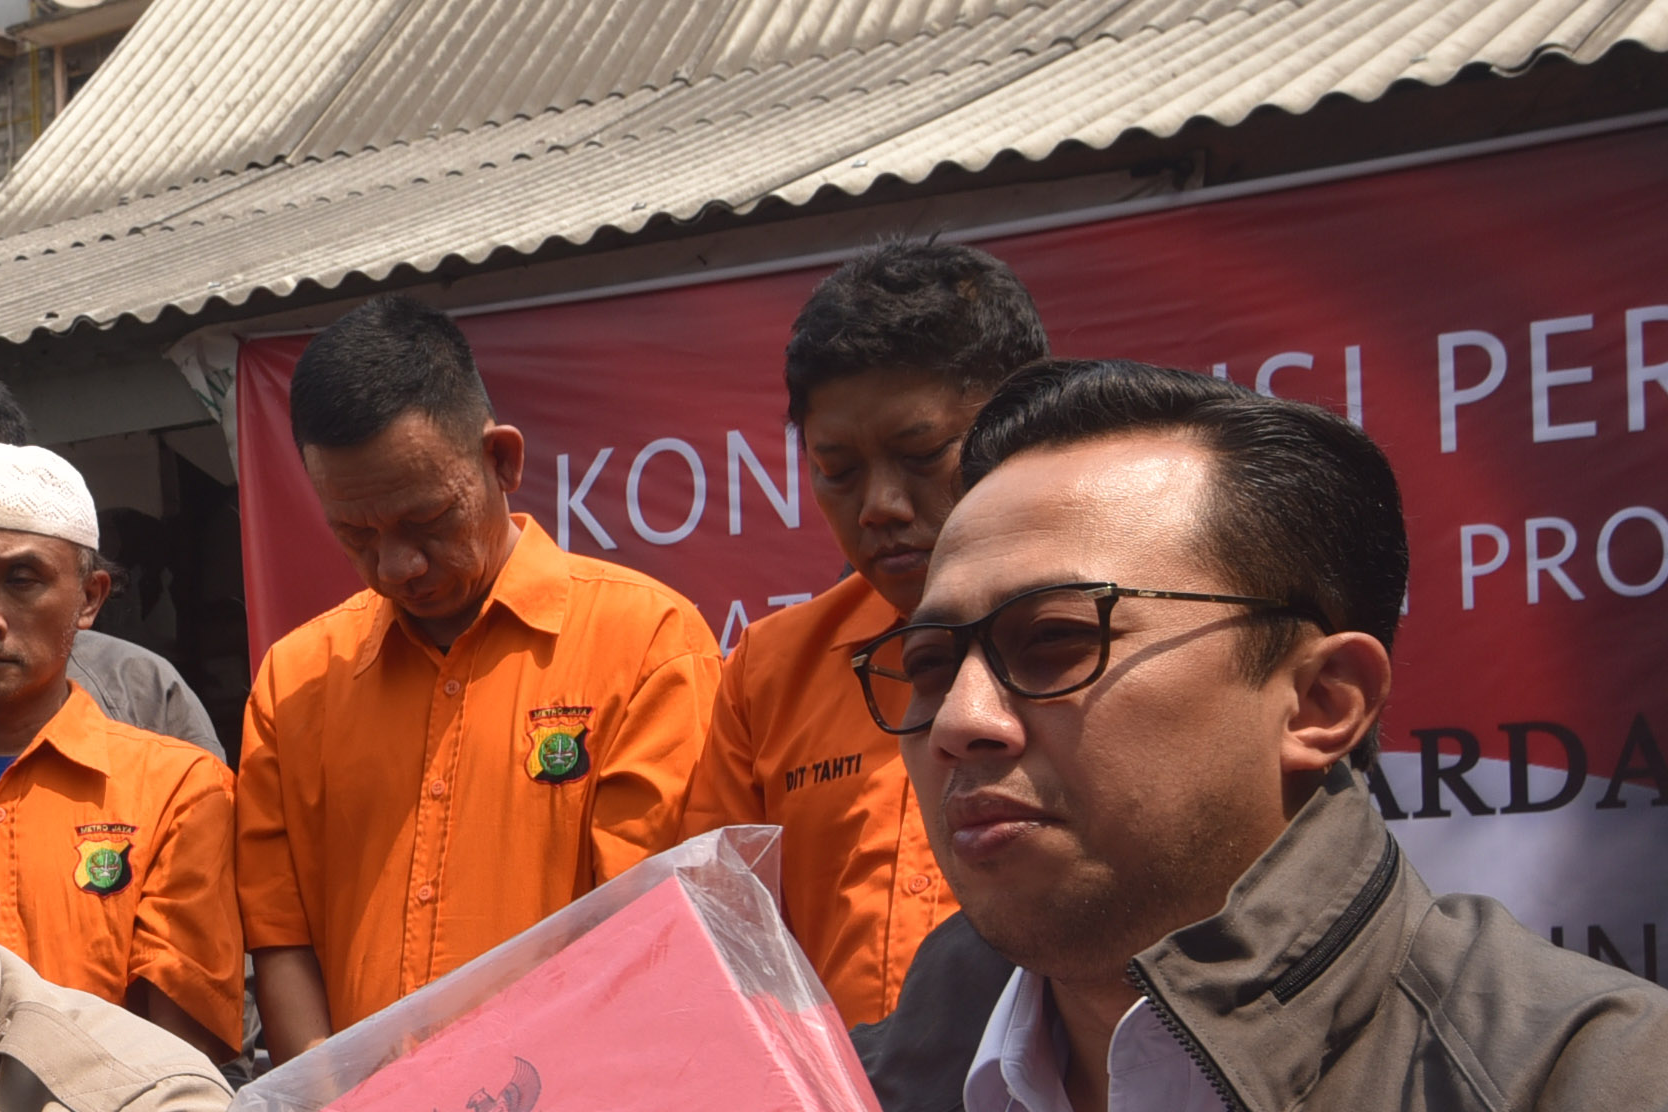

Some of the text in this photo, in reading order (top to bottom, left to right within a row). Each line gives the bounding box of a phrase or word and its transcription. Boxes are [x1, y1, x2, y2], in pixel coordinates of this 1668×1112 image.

[1460, 506, 1668, 610] PRO
[786, 753, 862, 792] DIT TAHTI
[80, 824, 133, 834] METRO JAYA
